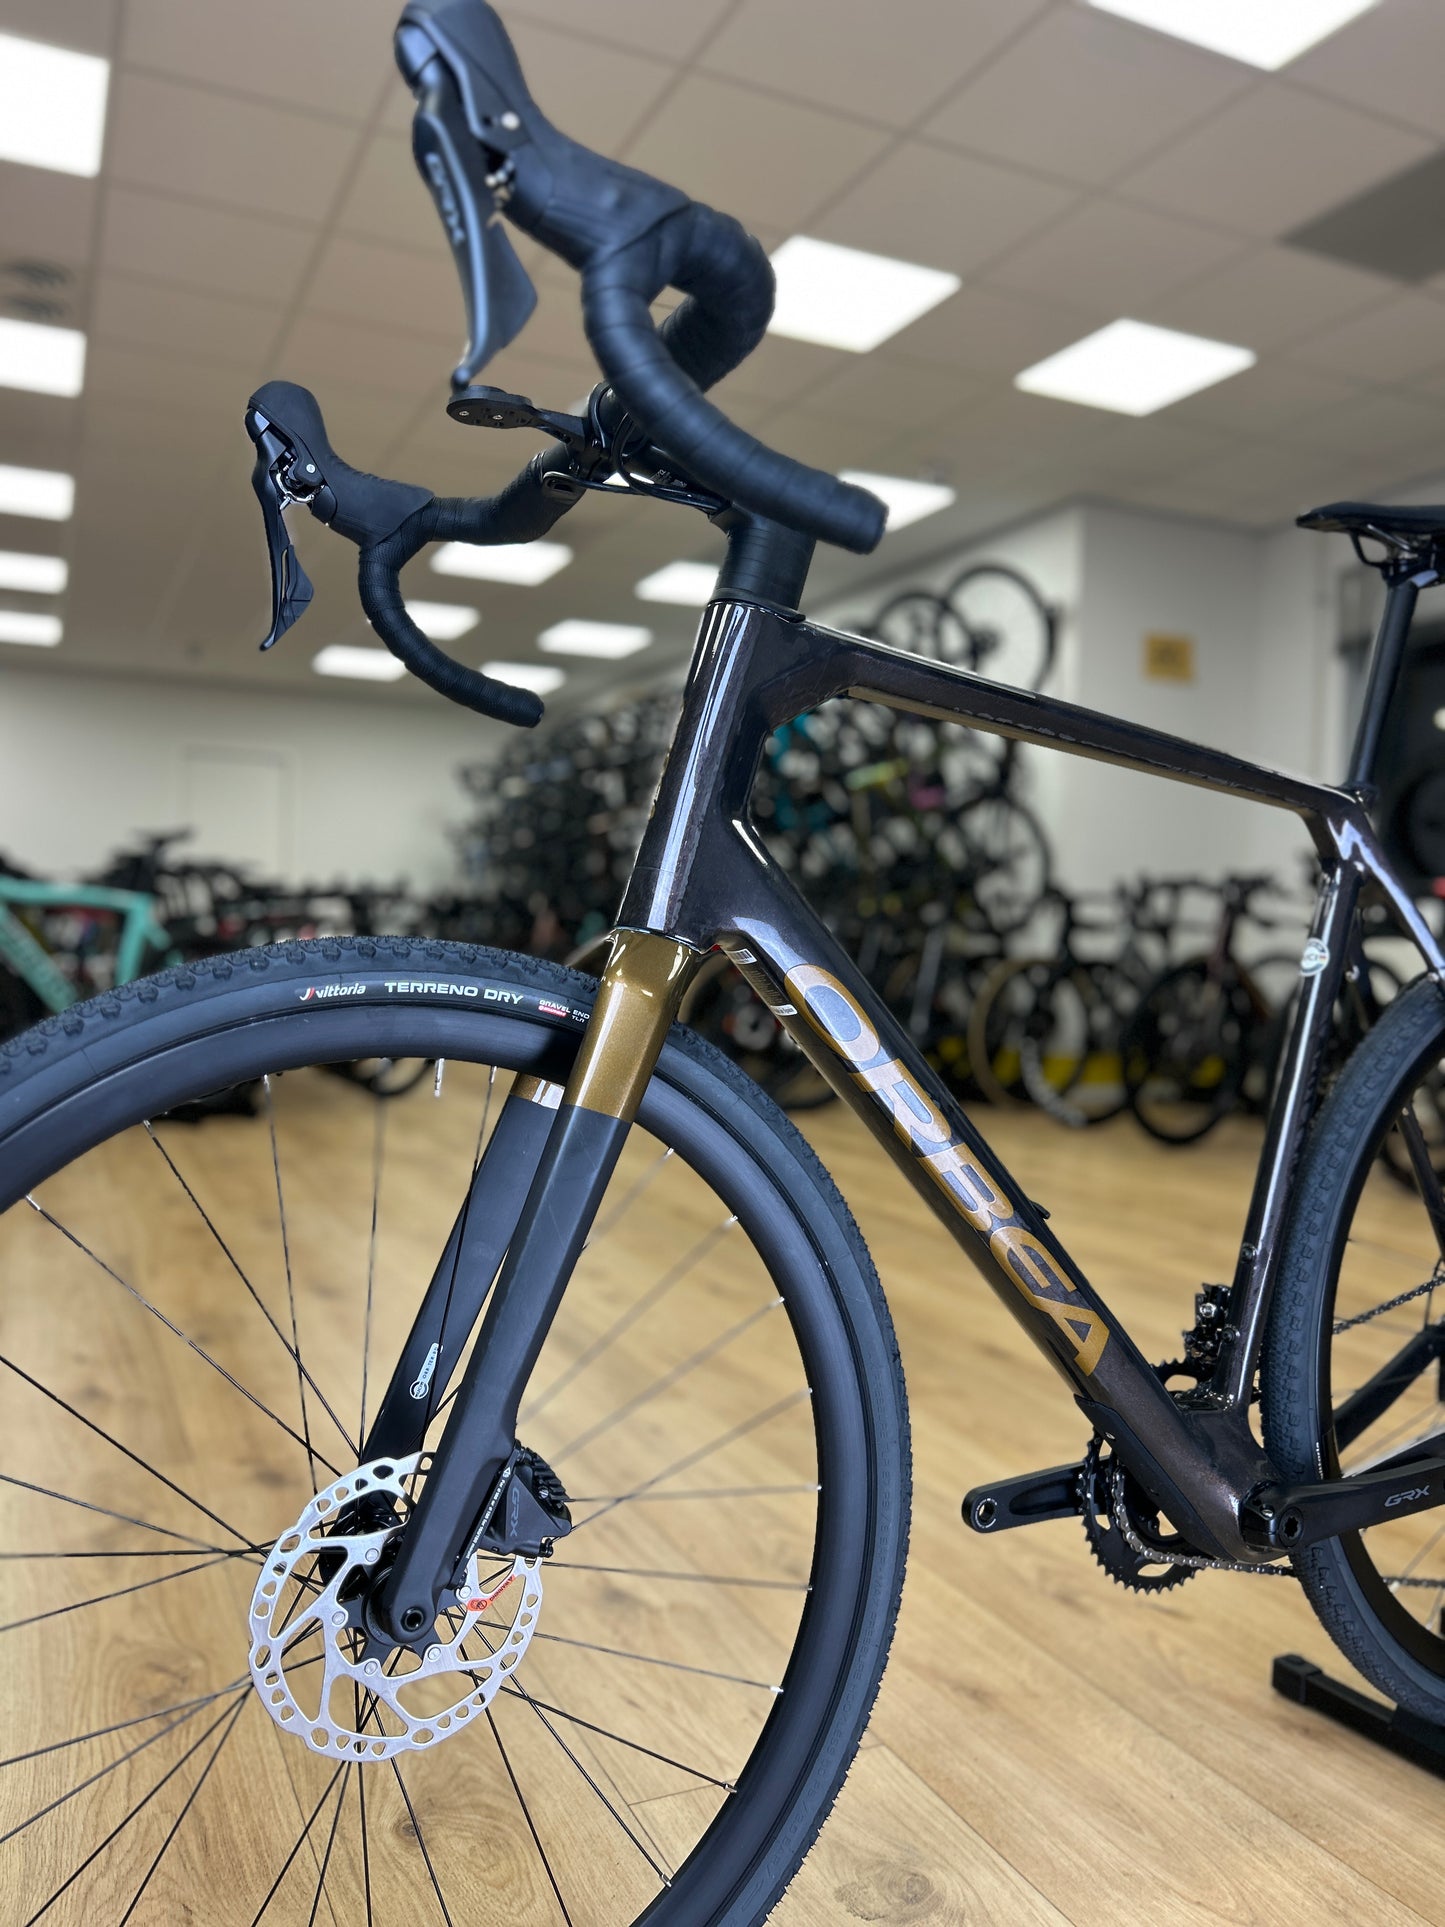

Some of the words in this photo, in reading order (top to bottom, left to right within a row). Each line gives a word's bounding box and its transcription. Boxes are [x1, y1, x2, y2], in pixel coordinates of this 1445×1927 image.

[315, 983, 367, 999] vittoria
[384, 982, 479, 997] TERRENO
[483, 988, 524, 1005] DRY
[539, 999, 571, 1013] GRAVEL
[784, 963, 1110, 1377] ORBEA
[1384, 1484, 1431, 1507] GRX
[509, 1486, 520, 1537] GRX
[489, 1580, 510, 1602] WARNING
